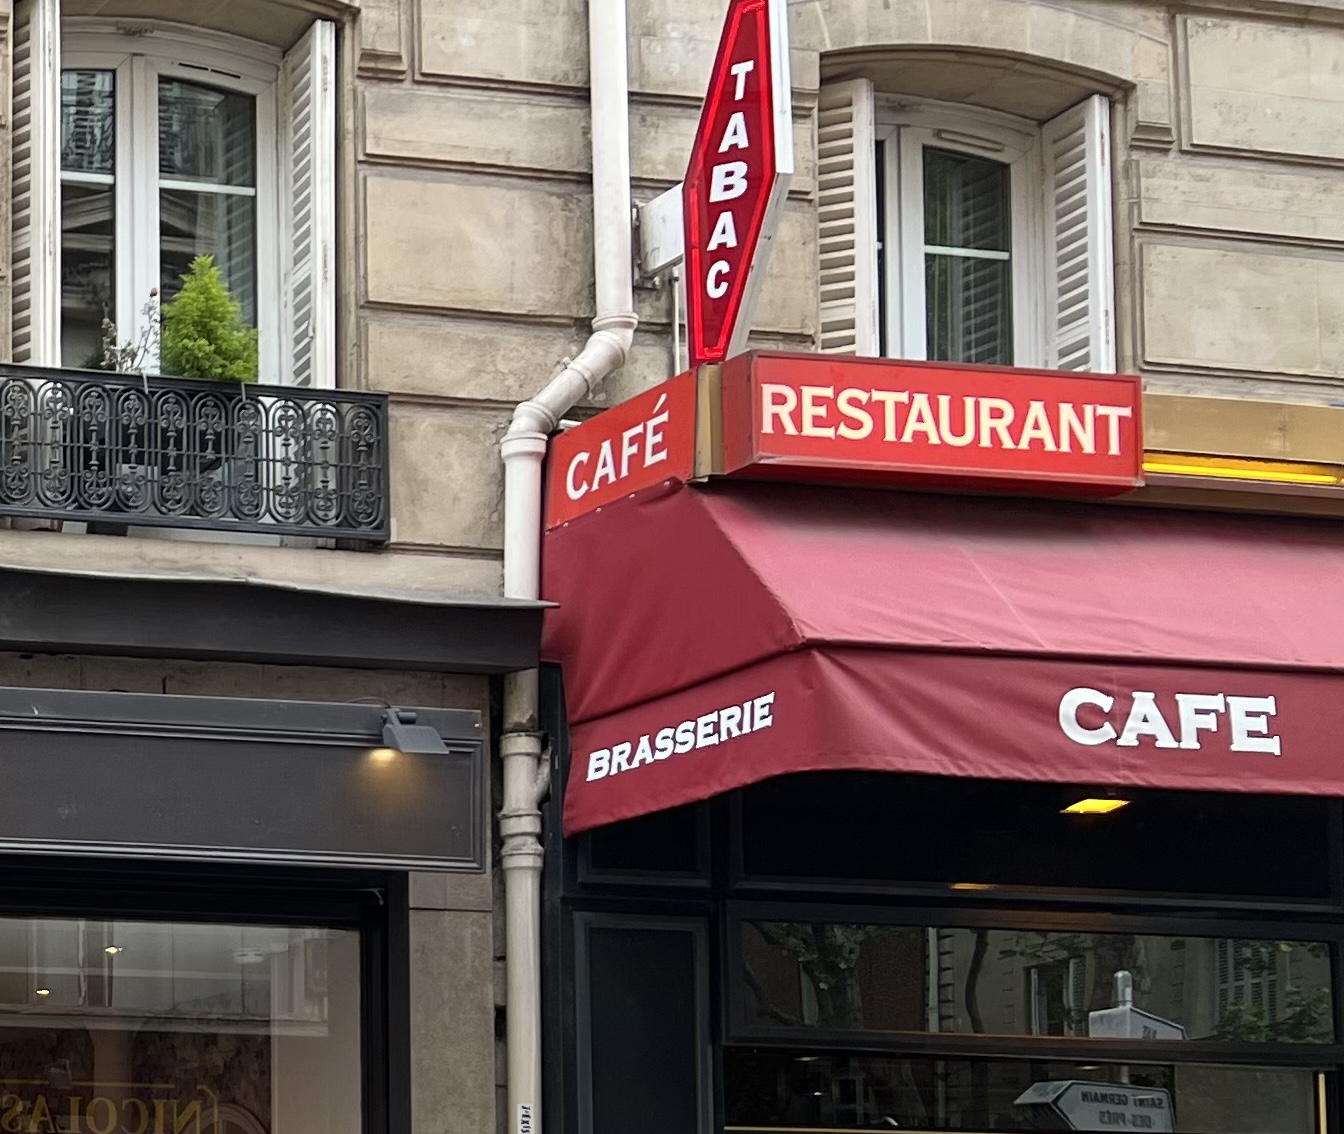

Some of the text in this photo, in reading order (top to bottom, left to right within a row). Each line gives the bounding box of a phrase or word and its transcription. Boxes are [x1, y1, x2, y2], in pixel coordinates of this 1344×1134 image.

[705, 60, 754, 299] TABAC
[566, 393, 670, 501] CAFÉ
[760, 383, 1133, 456] RESTAURANT
[586, 686, 1282, 782] BRASSERIE CAFE
